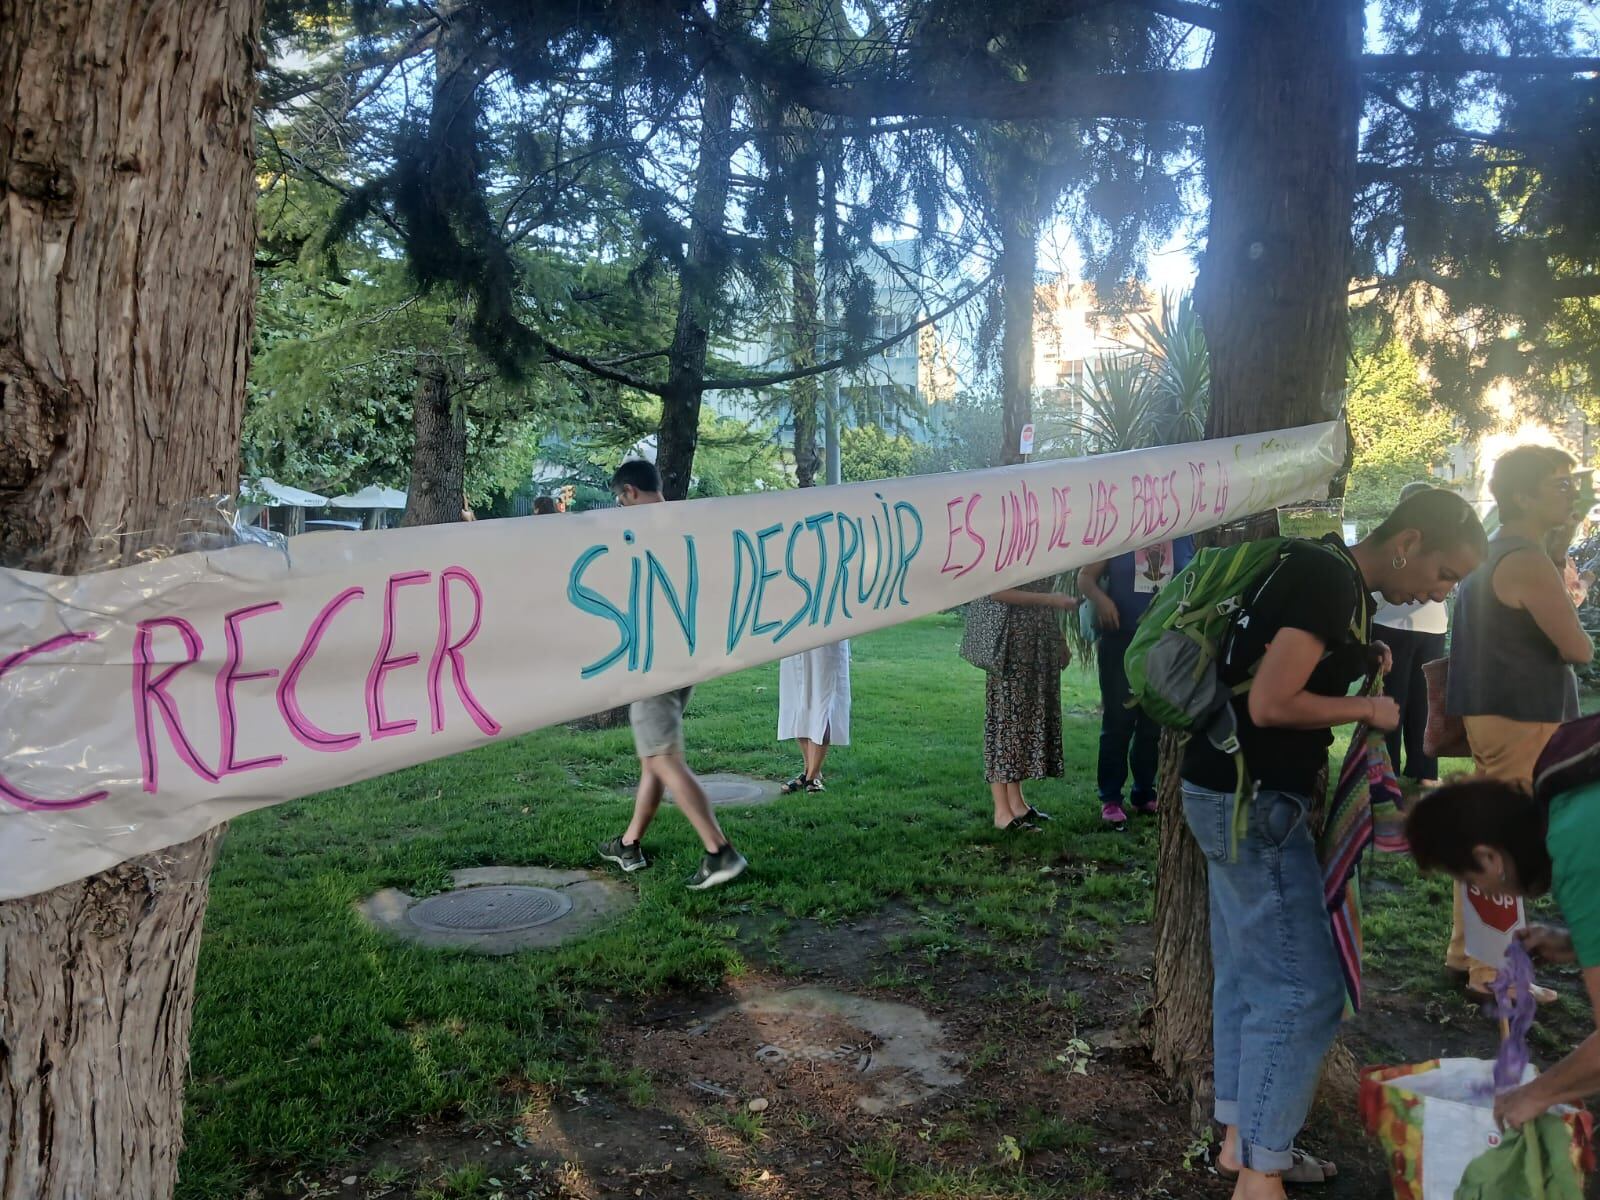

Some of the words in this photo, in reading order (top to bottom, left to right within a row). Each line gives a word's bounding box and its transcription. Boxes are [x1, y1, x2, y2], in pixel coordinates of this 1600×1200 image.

[0, 566, 502, 811] CRECER
[941, 493, 985, 580] ES
[995, 480, 1040, 572] UNA
[1047, 486, 1072, 552] DE
[1082, 479, 1119, 547] LAS
[1121, 470, 1181, 545] BASES
[1185, 461, 1207, 529] DE
[1214, 460, 1230, 521] LA
